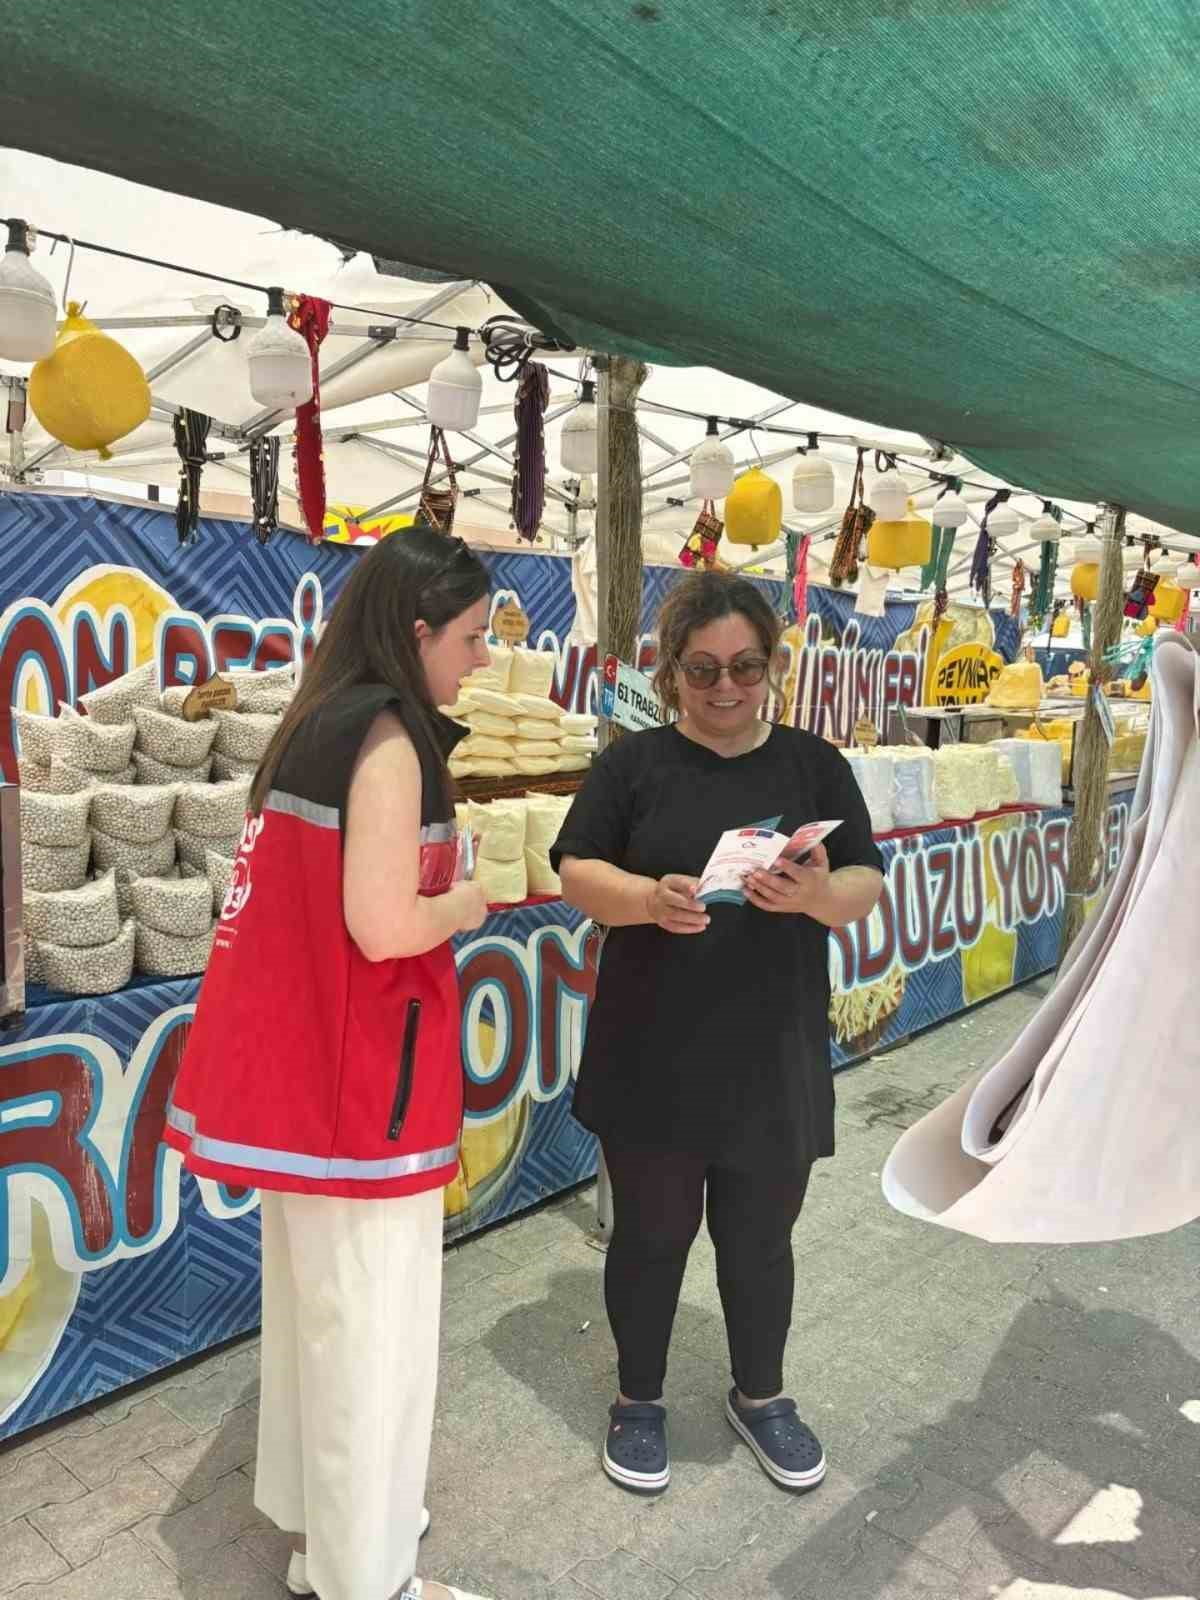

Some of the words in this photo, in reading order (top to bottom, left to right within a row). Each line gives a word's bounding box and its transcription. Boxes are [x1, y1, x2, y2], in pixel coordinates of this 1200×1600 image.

[617, 682, 629, 704] 61
[630, 688, 664, 725] TRABZ
[831, 821, 985, 990] DÜZÜ
